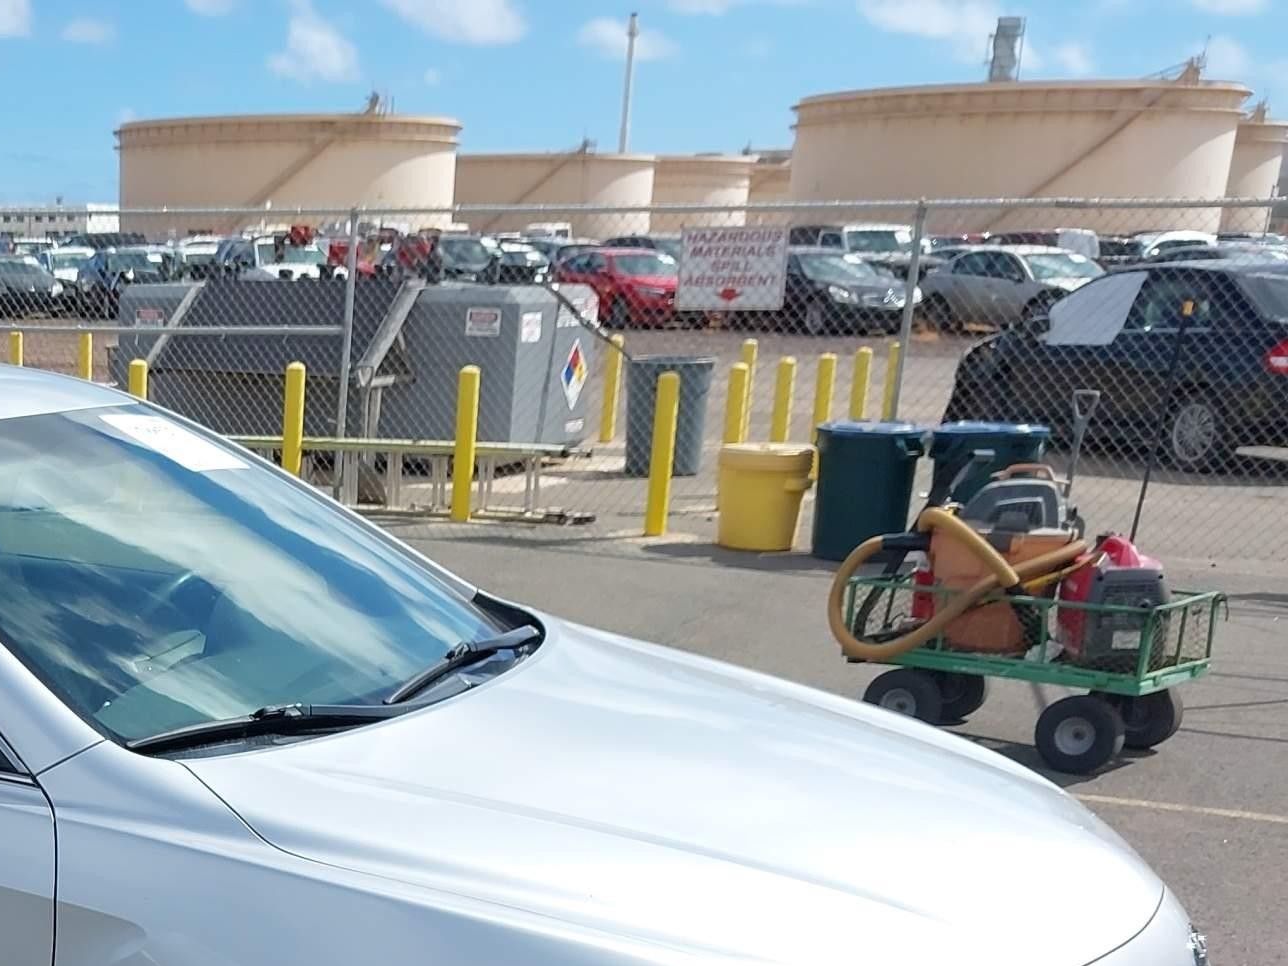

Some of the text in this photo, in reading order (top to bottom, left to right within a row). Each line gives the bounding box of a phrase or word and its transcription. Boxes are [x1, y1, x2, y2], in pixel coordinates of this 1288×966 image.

[685, 230, 782, 243] HAZARDOUS
[689, 245, 777, 257] MATERIALS
[710, 259, 753, 273] SPILL
[683, 273, 777, 287] ABSORBENT
